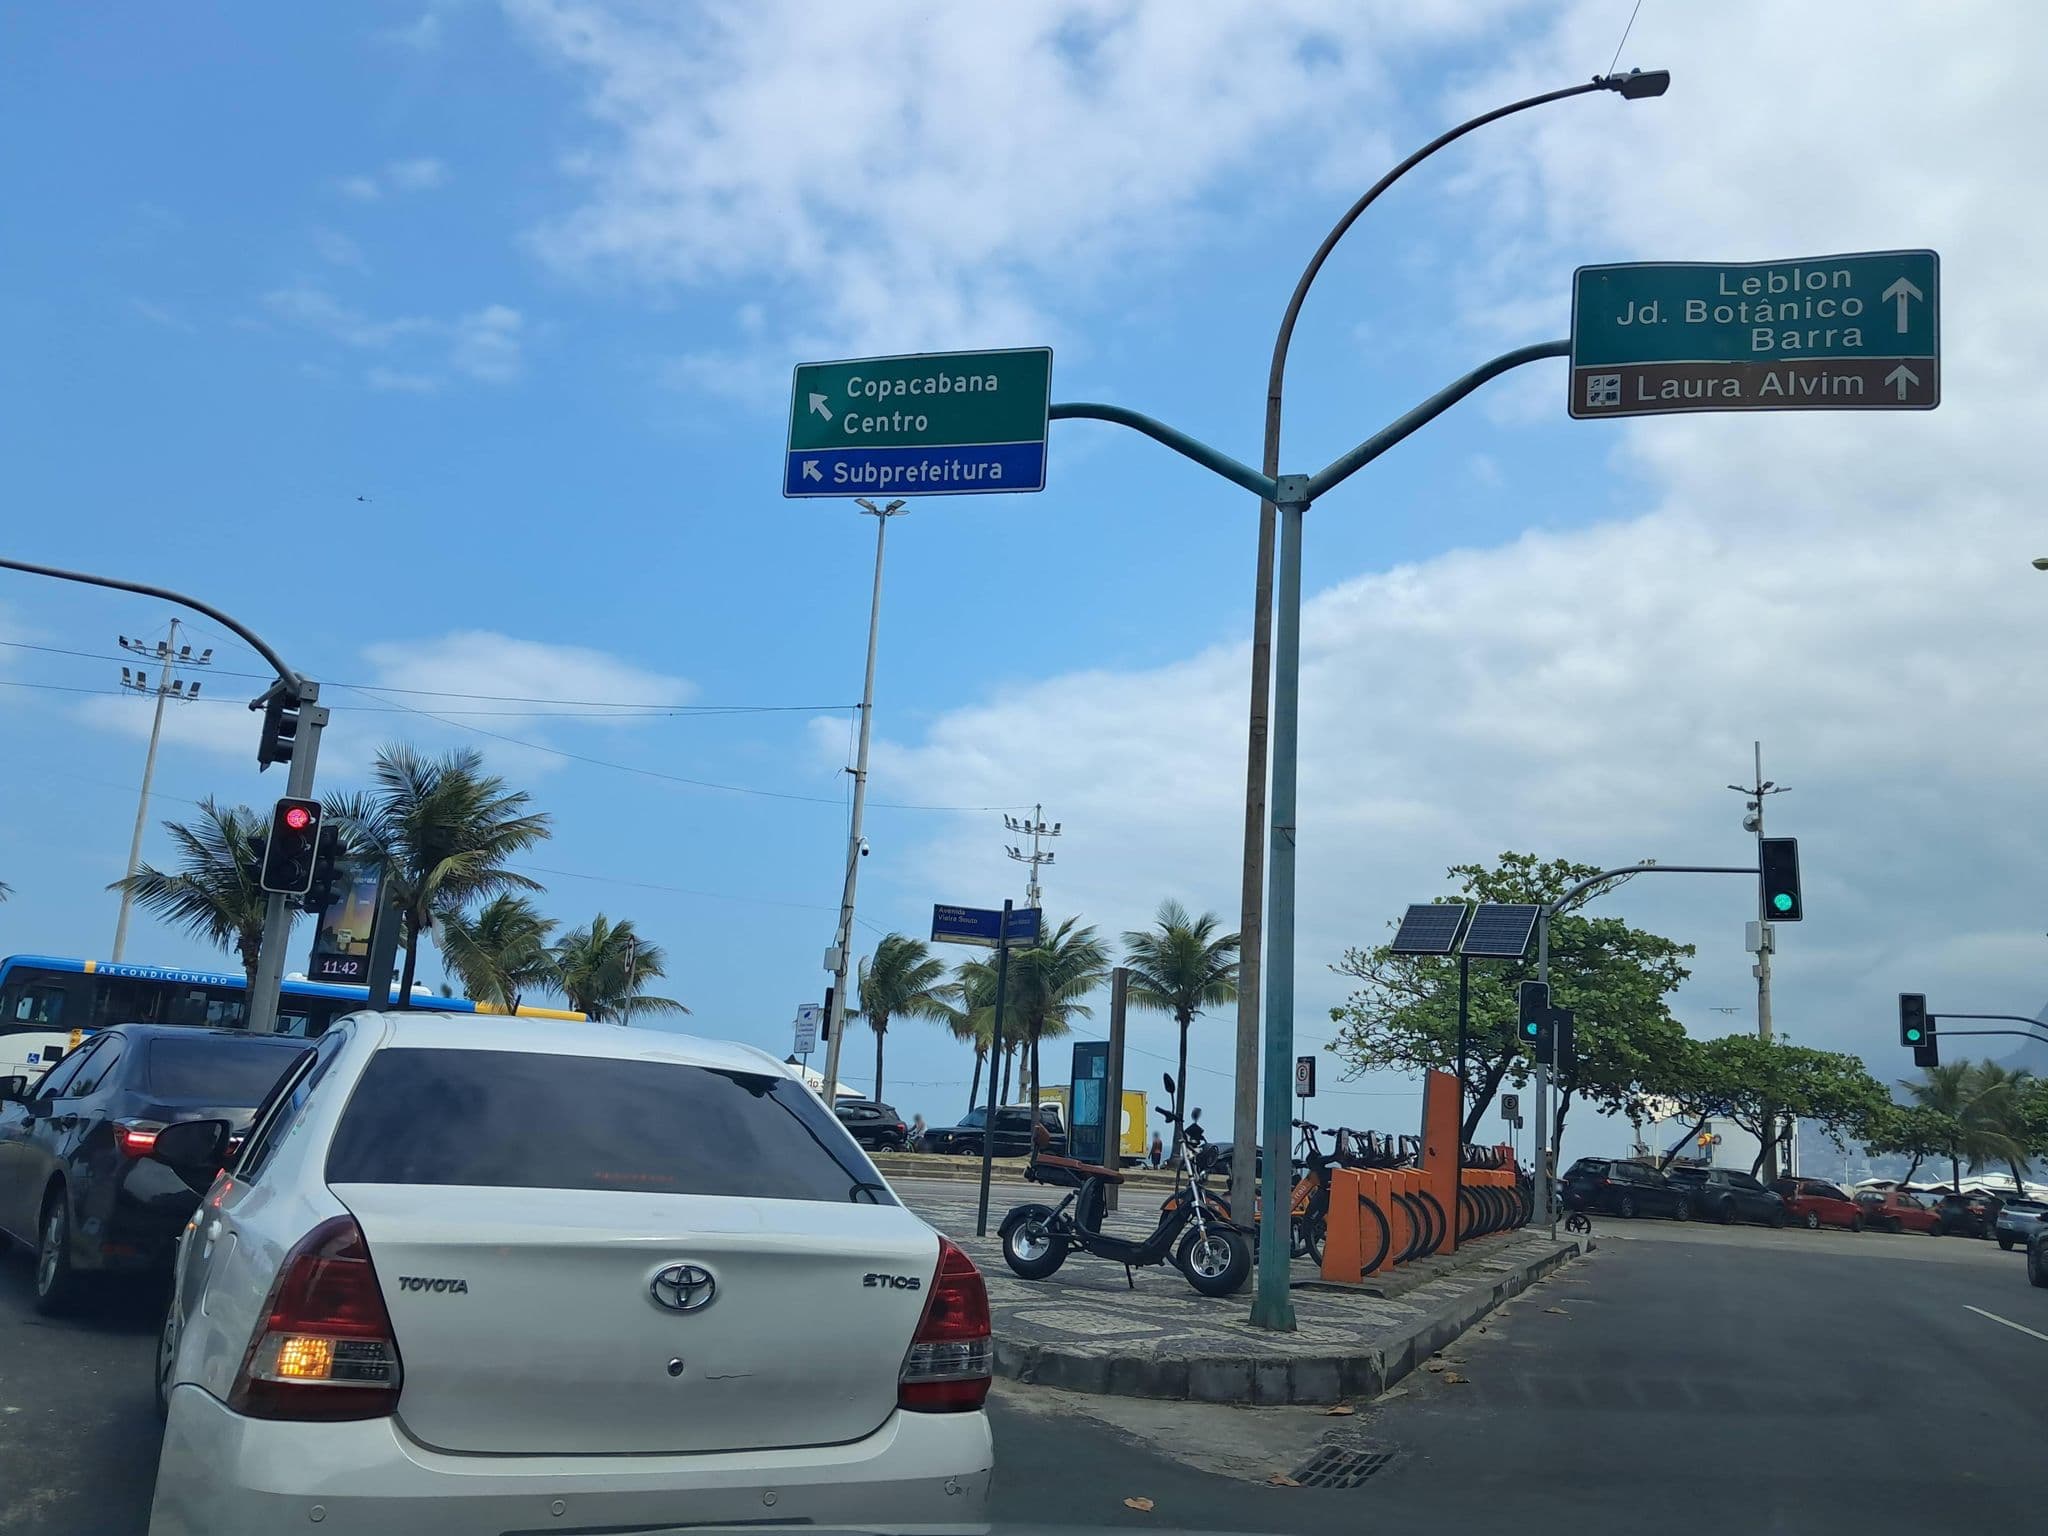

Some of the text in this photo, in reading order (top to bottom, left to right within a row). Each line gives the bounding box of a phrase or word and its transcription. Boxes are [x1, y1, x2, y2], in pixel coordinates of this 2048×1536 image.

[1718, 268, 1853, 297] Leblon
[1616, 296, 1864, 326] Jd. Botânico
[1750, 325, 1864, 352] Barra
[847, 372, 998, 402] Copacabana
[1637, 371, 1865, 401] Laura Alvim
[843, 410, 929, 434] Centro
[833, 459, 1003, 488] Subprefeitura
[98, 966, 227, 984] AR CONDICIONADO
[398, 1276, 468, 1294] TOYOTA
[863, 1273, 921, 1290] ETIOS
